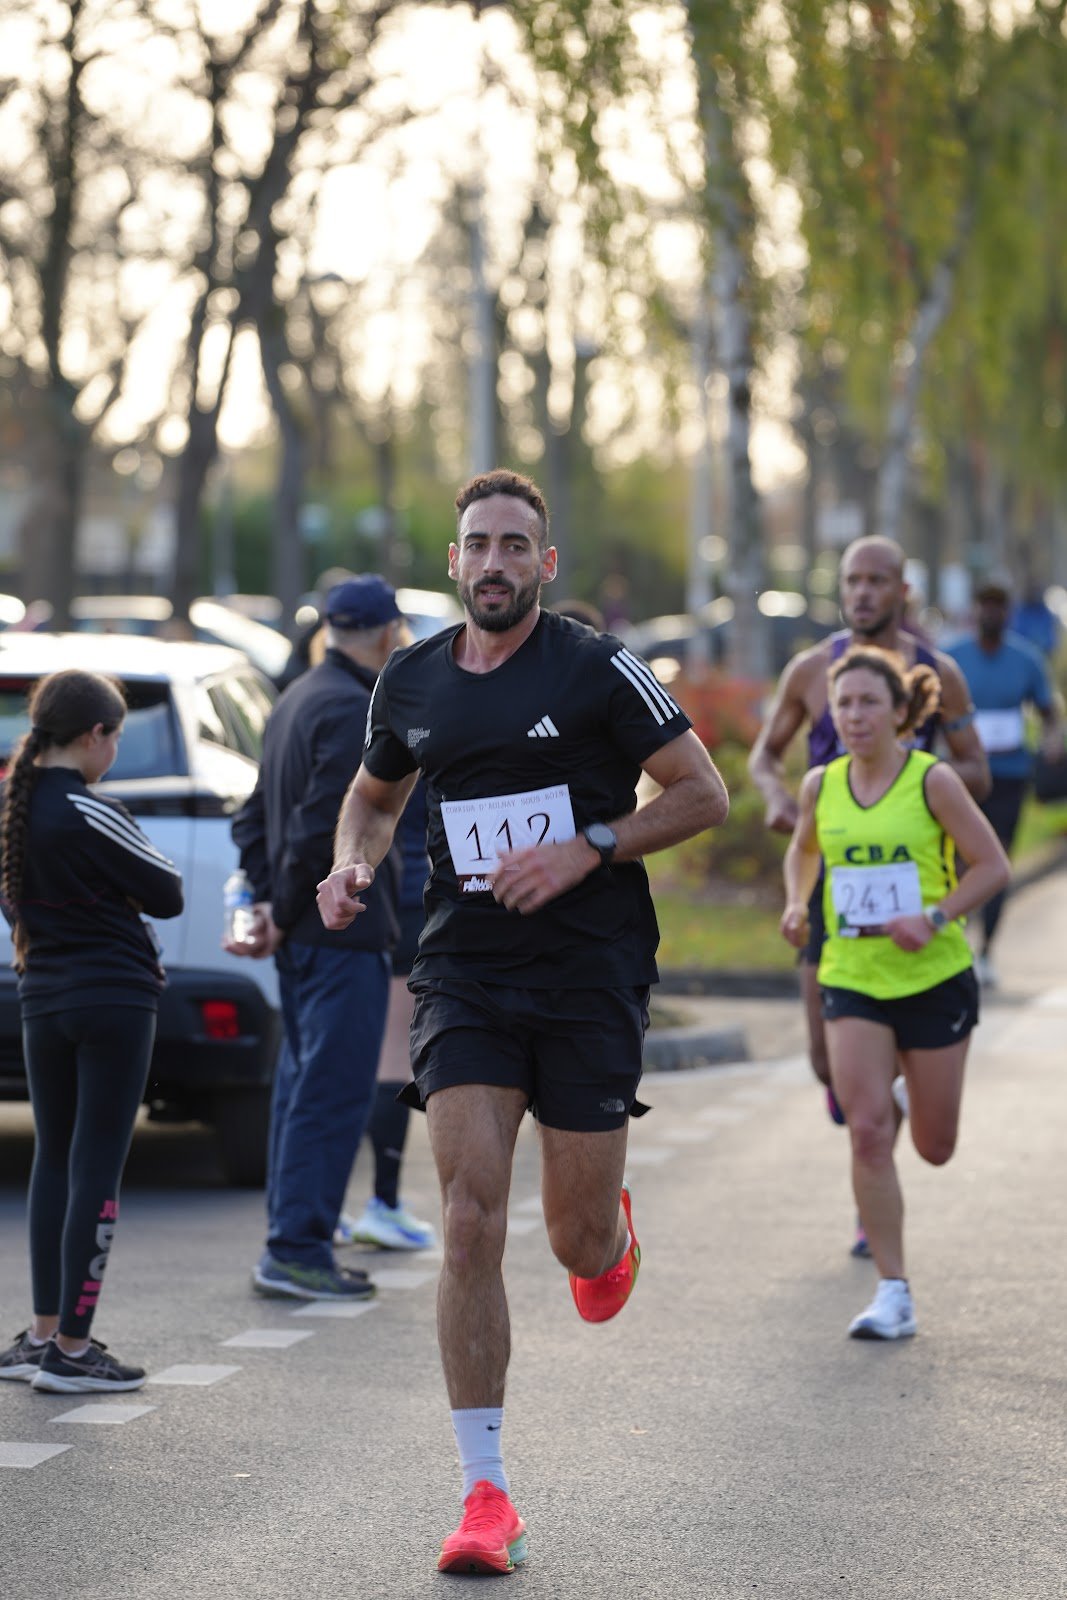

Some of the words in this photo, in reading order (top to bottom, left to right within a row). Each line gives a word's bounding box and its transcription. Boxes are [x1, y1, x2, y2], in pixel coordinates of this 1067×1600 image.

[466, 812, 556, 861] 112
[844, 844, 911, 864] CBA
[841, 882, 904, 914] 241
